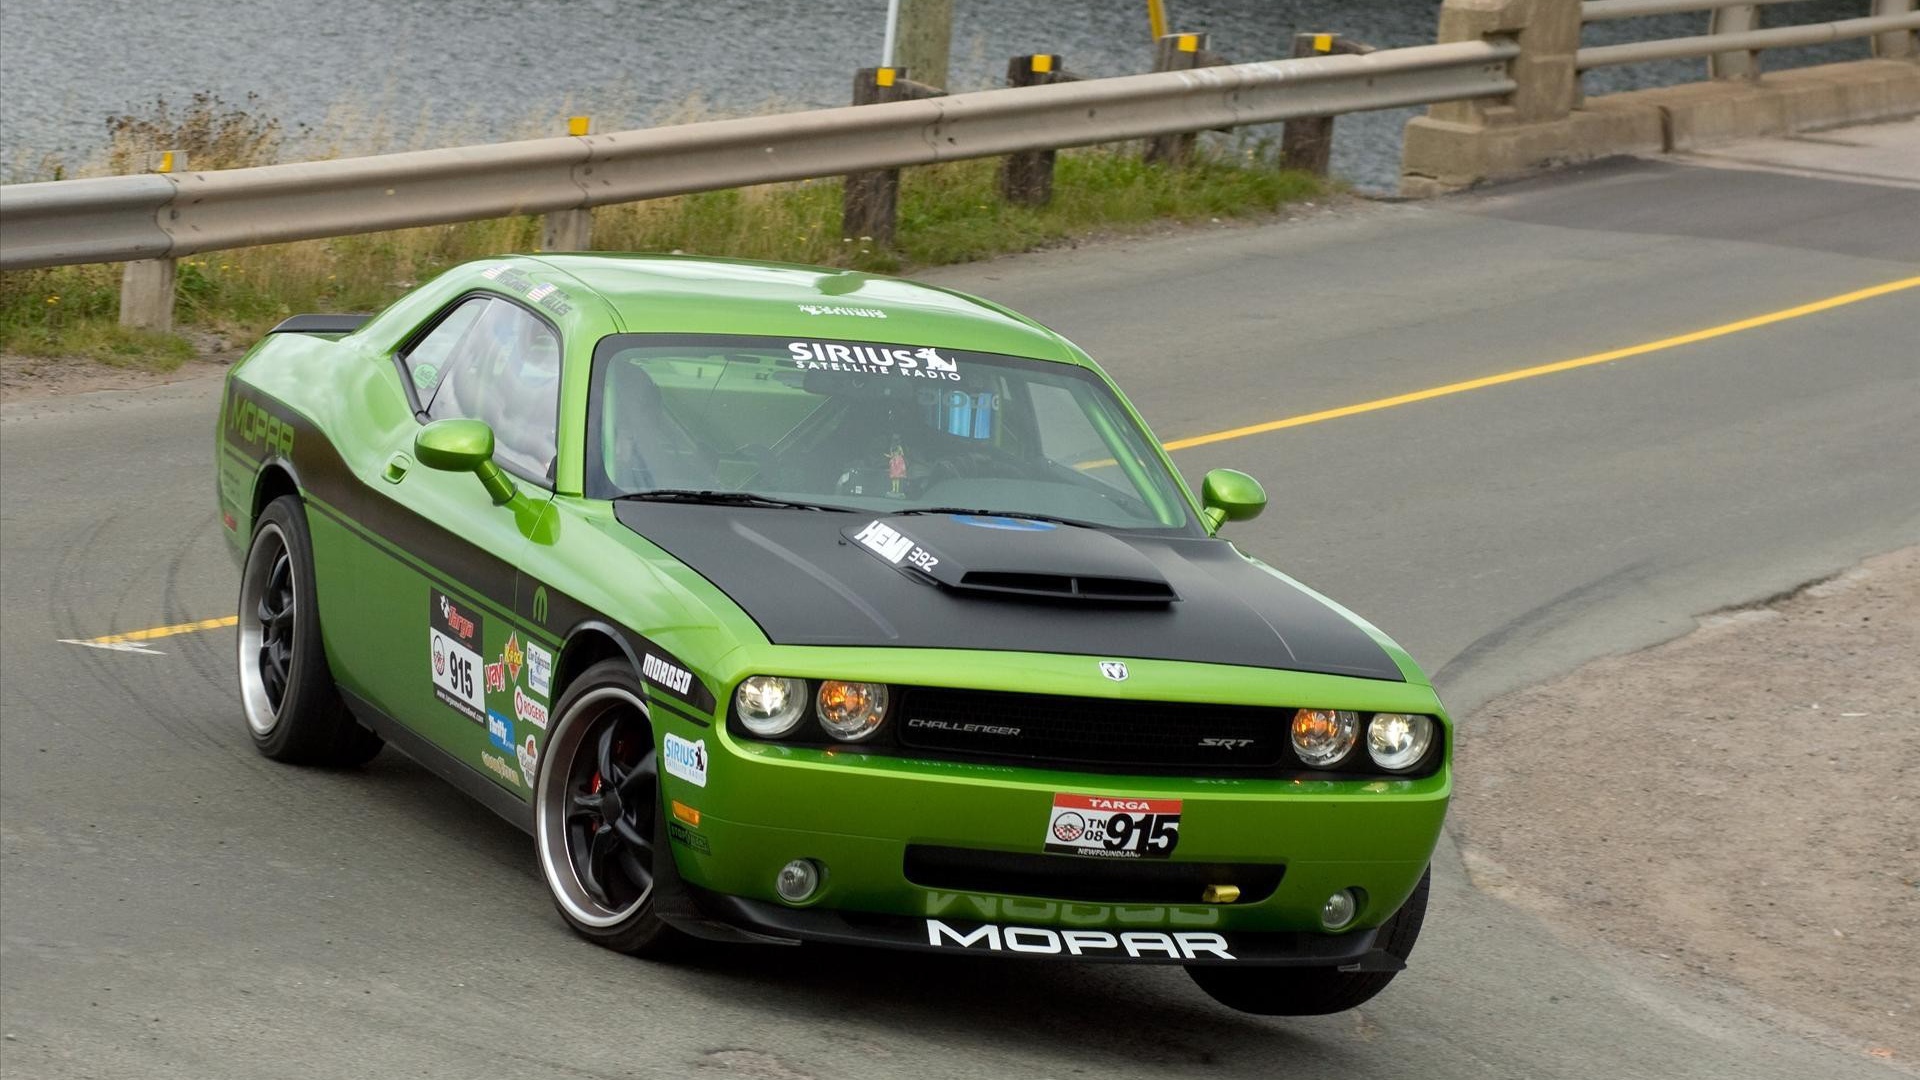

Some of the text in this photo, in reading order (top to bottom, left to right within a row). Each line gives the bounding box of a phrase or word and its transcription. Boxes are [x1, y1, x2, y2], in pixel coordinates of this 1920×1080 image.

[788, 342, 918, 369] SIRIUS
[796, 360, 961, 381] SATELLITE RADIO
[229, 391, 295, 458] MOPAR
[854, 520, 939, 572] HEMI 392
[448, 605, 474, 639] Targa
[450, 651, 473, 699] 915
[643, 653, 692, 695] MOROSO
[524, 701, 545, 724] ROGERS
[908, 718, 1020, 736] CHALLENGER
[666, 740, 695, 767] SIRIUS
[1198, 738, 1254, 750] SRT
[1089, 798, 1150, 811] TARGA
[1084, 830, 1104, 841] 08
[1088, 818, 1107, 829] TN
[1103, 812, 1181, 856] 915
[926, 919, 1238, 960] MOPAR
